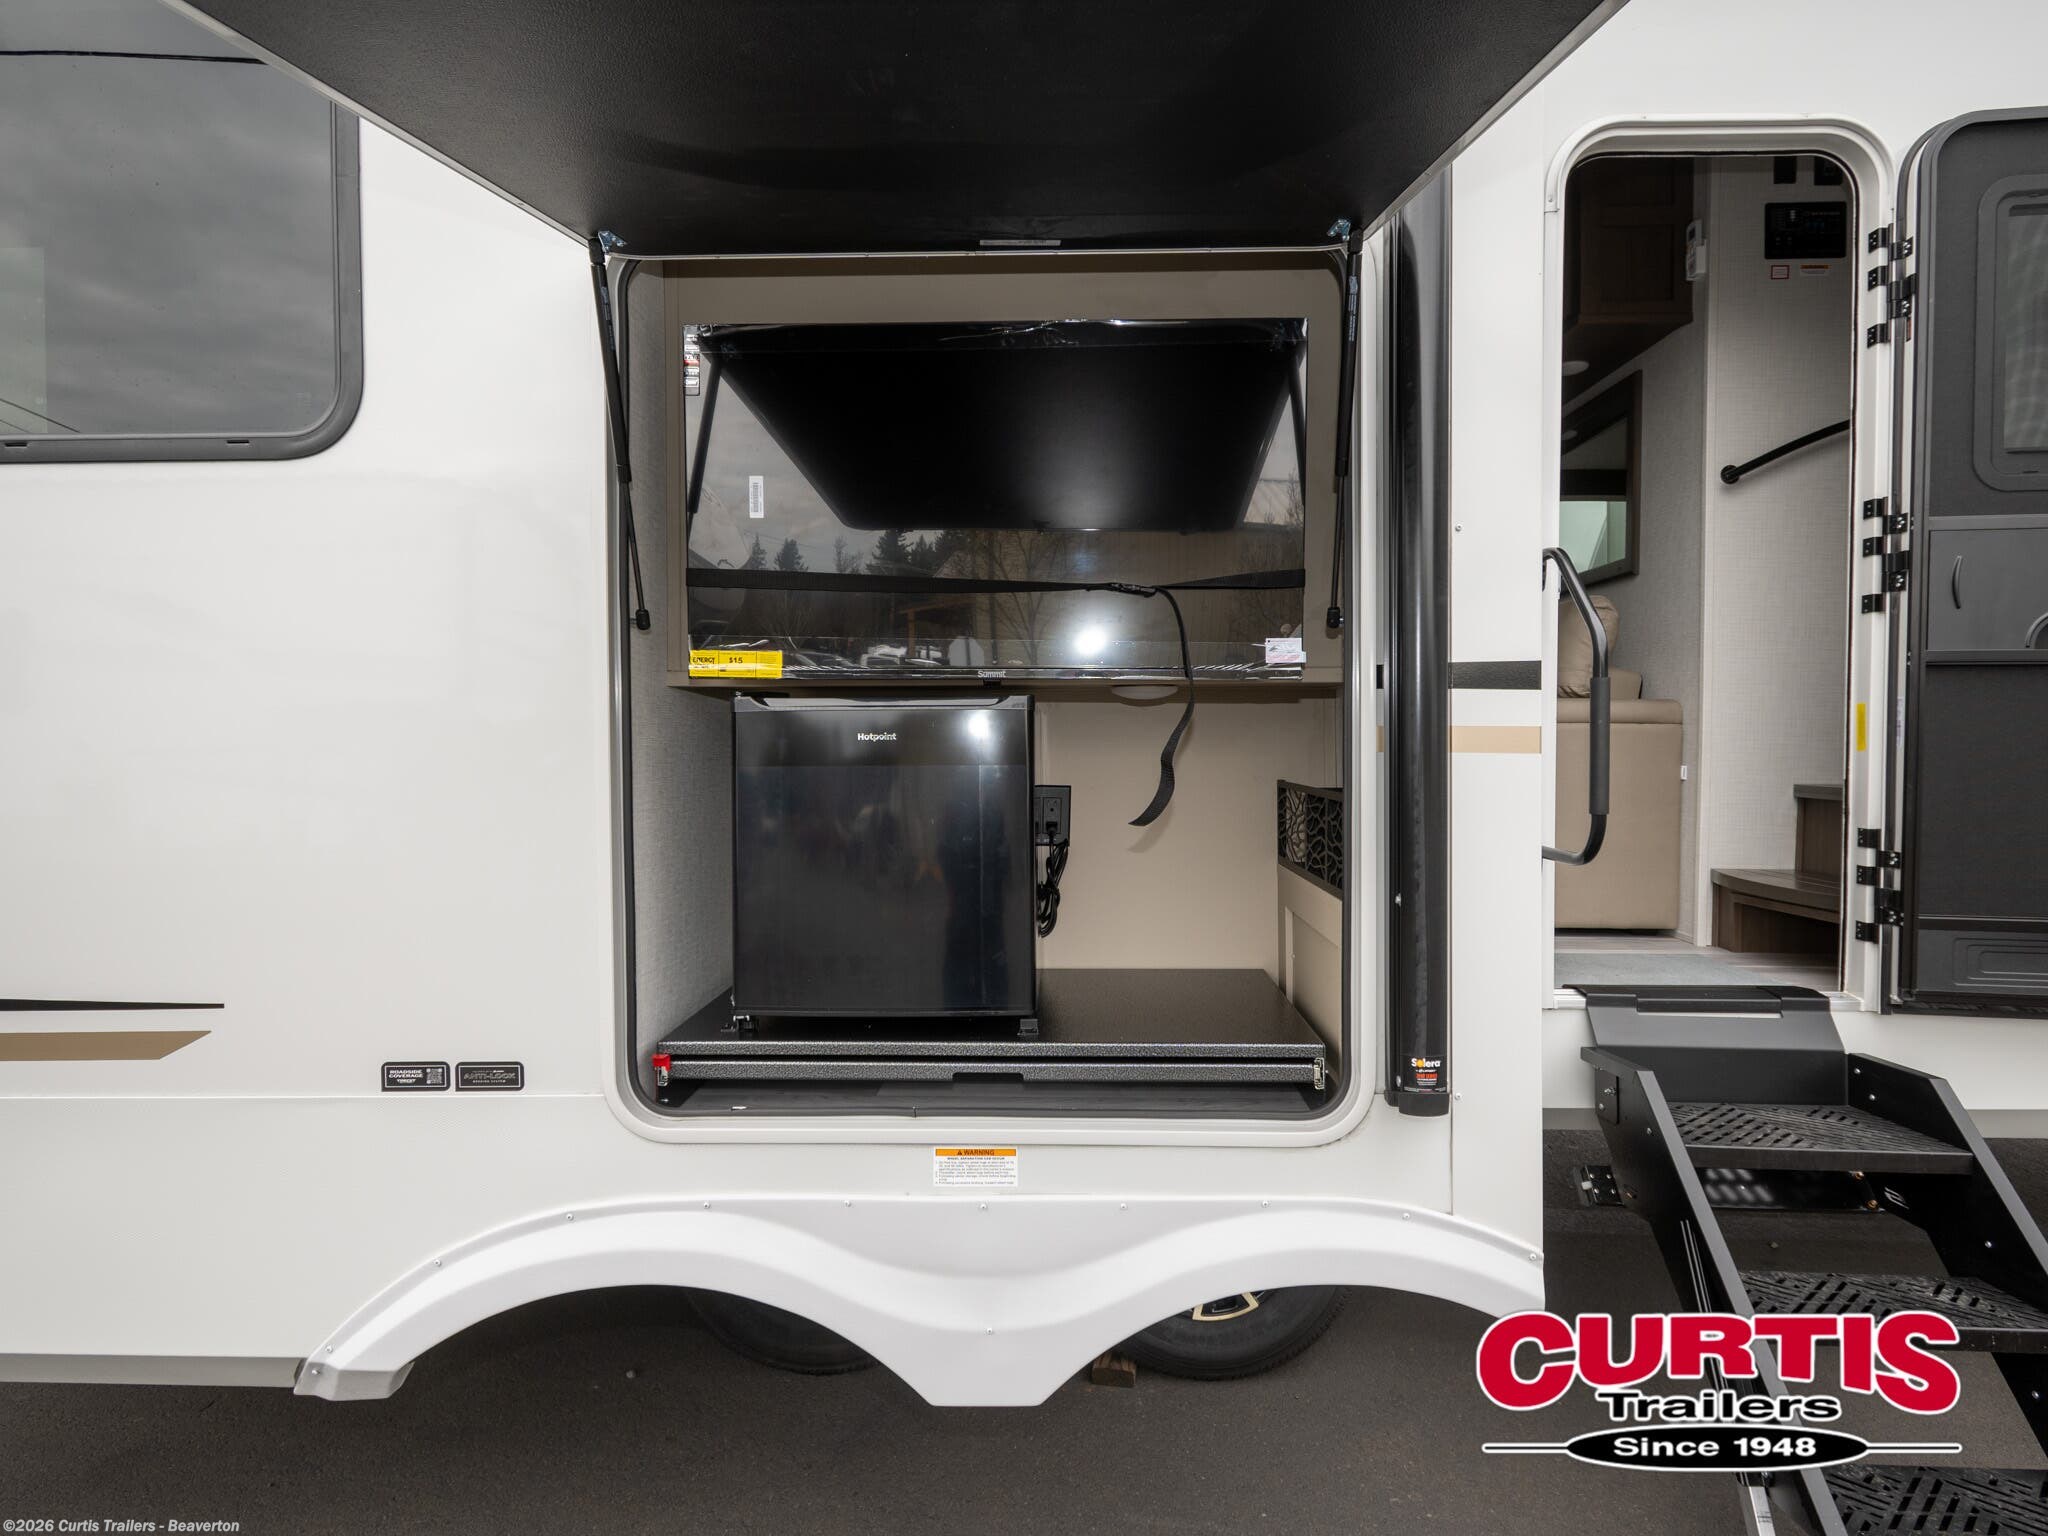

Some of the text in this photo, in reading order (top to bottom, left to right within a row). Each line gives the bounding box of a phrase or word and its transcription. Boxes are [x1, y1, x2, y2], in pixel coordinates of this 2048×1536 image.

[977, 670, 1006, 678] Summit
[857, 732, 897, 742] Hotpoint
[1411, 1058, 1441, 1068] Solera
